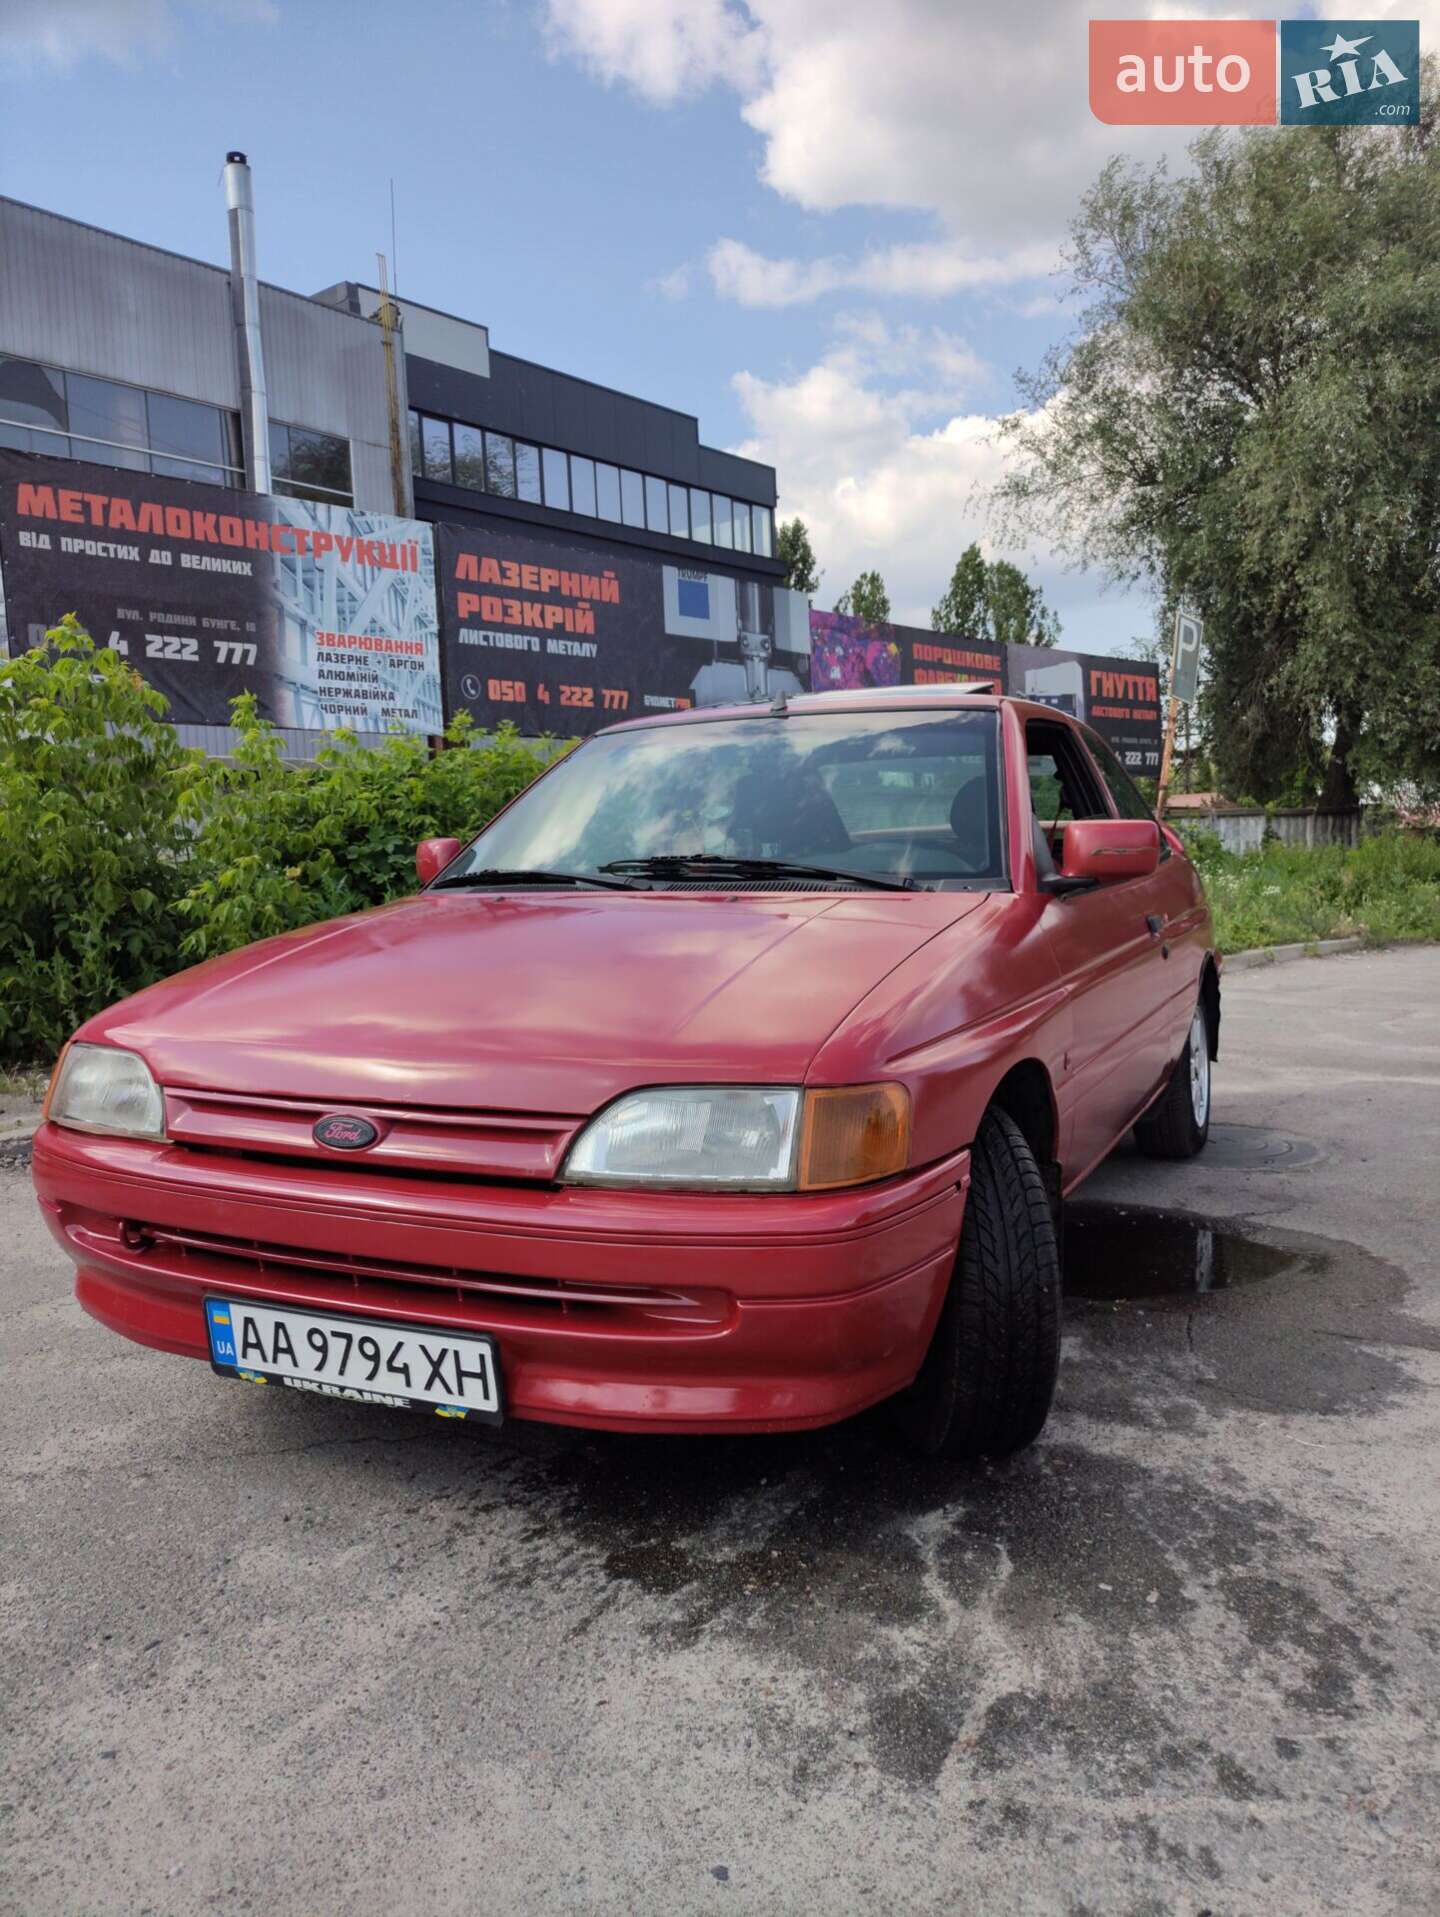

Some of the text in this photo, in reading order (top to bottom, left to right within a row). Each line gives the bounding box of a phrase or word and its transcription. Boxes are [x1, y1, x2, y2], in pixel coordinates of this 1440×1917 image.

[16, 482, 420, 573] МЕТАЛОКОНСТРУКЦІЇ
[18, 531, 254, 577] ВІД ПРОСТИХ ДО ВЕЛИКИХ
[455, 553, 620, 604] ЛАЗЕРНИЙ
[457, 591, 595, 635] РОЗКРІЙ
[108, 630, 129, 656] 4
[145, 633, 200, 662] 222
[213, 641, 258, 666] 777
[316, 631, 424, 656] ЗВАРЮВАННЯ
[458, 628, 597, 658] ЛИСТОВОГО МЕТАЛУ
[913, 642, 1001, 671] ПОРОШКОВЕ
[1177, 618, 1198, 670] P
[316, 651, 370, 667] ЛАЗЕРНЕ
[388, 658, 425, 671] АРГОН
[318, 669, 379, 684] АЛЮМІНІЙ
[1090, 670, 1157, 702] ГНУТТЯ
[319, 686, 396, 702] НЕРЖАВІЙКА
[487, 678, 629, 711] 050 4 222 777
[320, 702, 419, 719] ЧОРНИЙ МЕТАЛ
[1125, 751, 1142, 766] 222
[1145, 752, 1159, 766] 777
[325, 1122, 362, 1141] Ford
[217, 1341, 234, 1356] UA
[283, 1377, 411, 1408] UKRAINE
